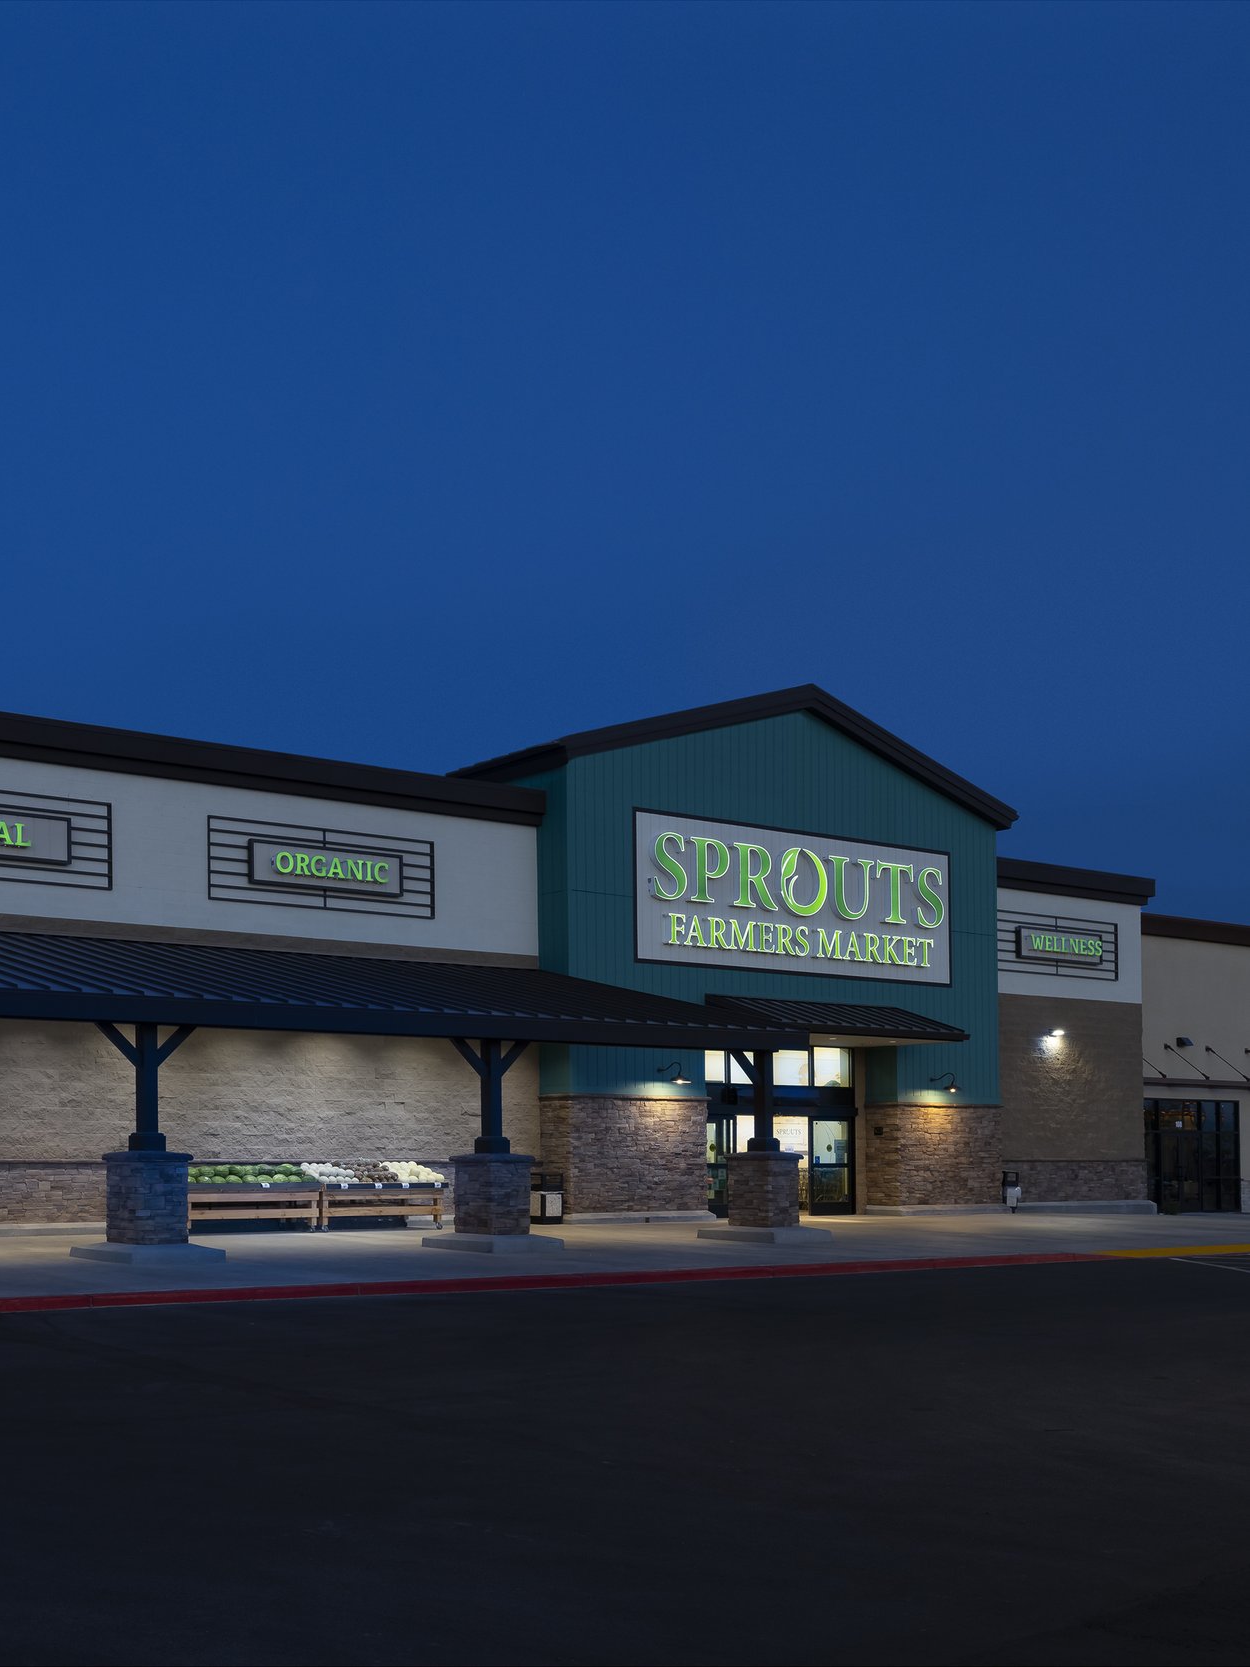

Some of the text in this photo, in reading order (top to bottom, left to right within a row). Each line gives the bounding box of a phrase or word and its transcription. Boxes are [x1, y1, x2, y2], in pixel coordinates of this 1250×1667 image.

[274, 850, 389, 885] ORGANIC
[652, 831, 945, 928] SPROUTS
[668, 912, 934, 967] FARMERS MARKET
[1031, 934, 1103, 957] WELLNESS
